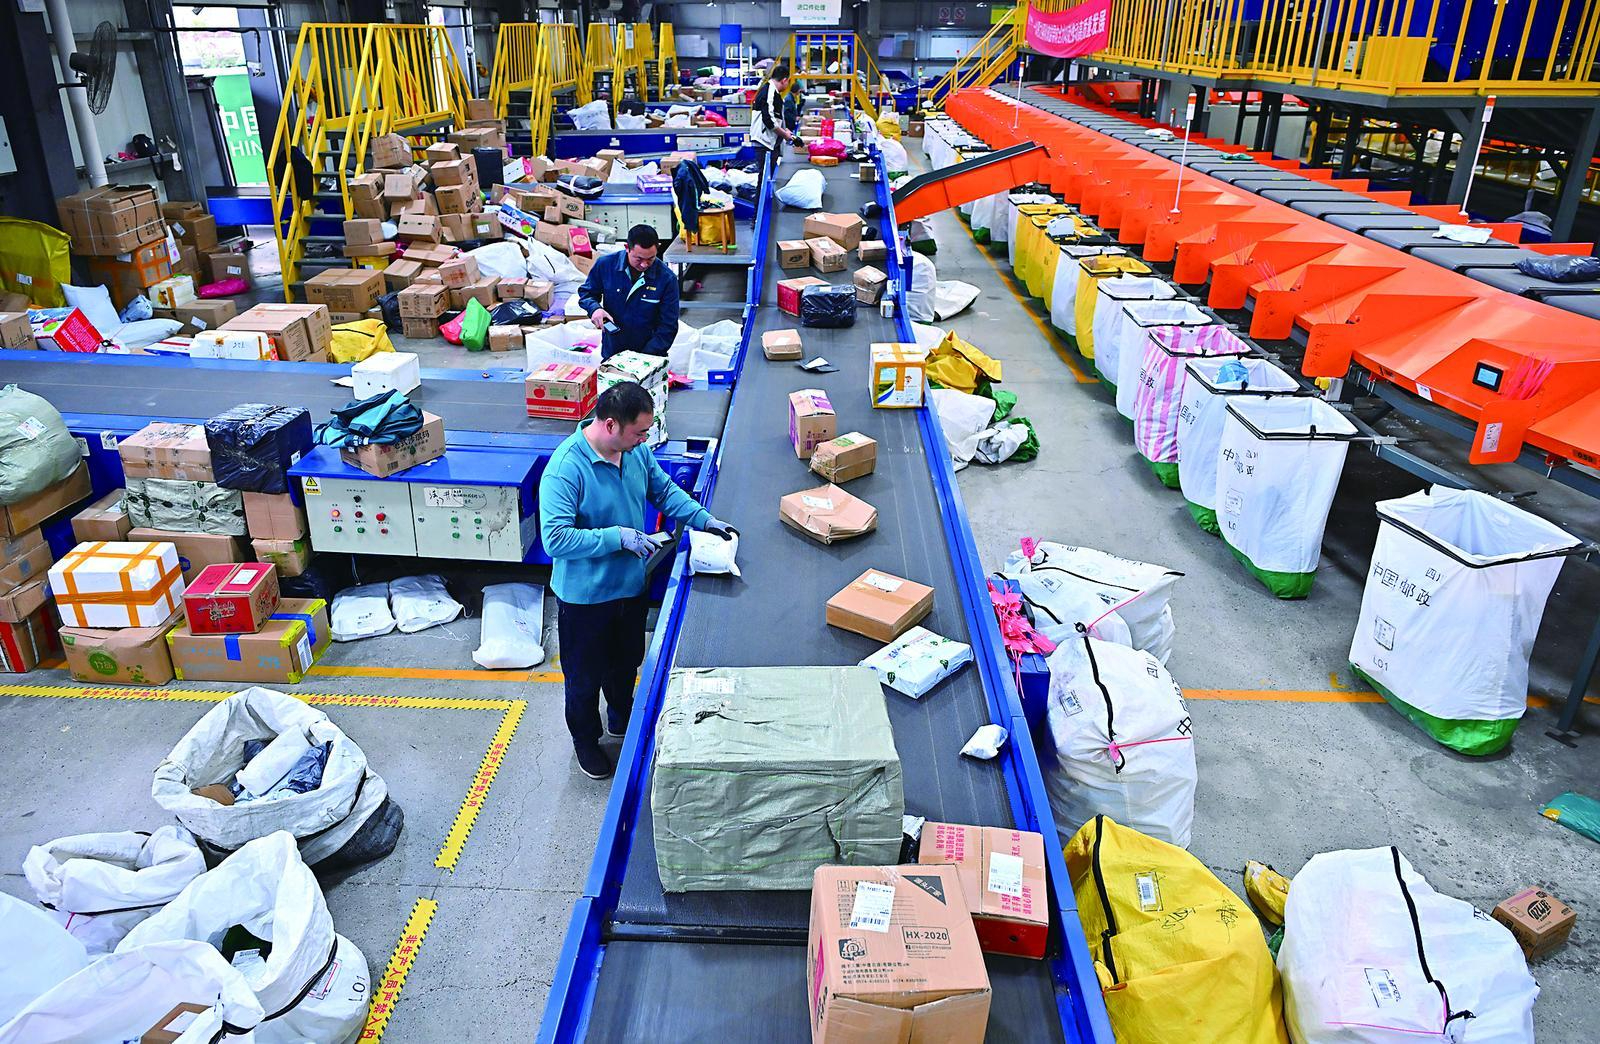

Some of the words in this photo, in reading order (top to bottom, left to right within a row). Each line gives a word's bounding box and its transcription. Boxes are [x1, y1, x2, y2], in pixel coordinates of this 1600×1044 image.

[1373, 562, 1432, 607] 中国邮政
[81, 688, 170, 698] 非生产人员严禁入内
[309, 696, 399, 705] 非生产人员严禁入内
[466, 742, 505, 808] 非生产人员严禁入内
[906, 930, 949, 941] HX-2020
[361, 934, 418, 1040] 非生产人员严禁入内
